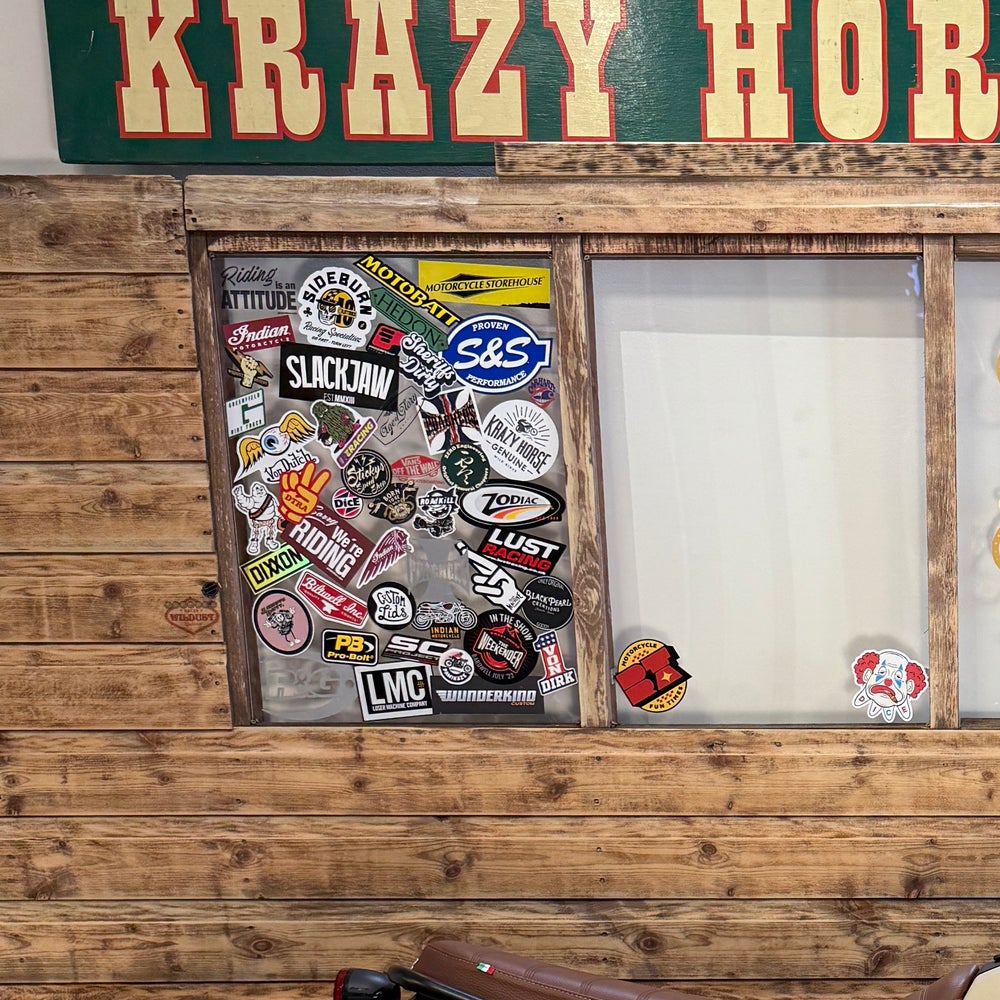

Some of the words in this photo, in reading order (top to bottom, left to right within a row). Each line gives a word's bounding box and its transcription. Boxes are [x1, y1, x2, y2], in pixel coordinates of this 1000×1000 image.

[114, 0, 628, 142] KRAZY
[222, 266, 278, 287] Riding
[284, 282, 296, 290] an
[424, 278, 485, 293] MOTORCYCLE
[486, 277, 543, 289] STOREHOUSE
[222, 290, 297, 311] ATTITUDE
[303, 271, 372, 315] SIDEBURN
[361, 255, 460, 327] MOTOBATT
[381, 293, 442, 347] HEDON
[472, 322, 509, 332] PROVEN
[228, 324, 291, 346] Indian
[453, 337, 532, 369] S&S
[286, 355, 395, 401] SLACKJAW
[466, 370, 527, 387] PERFORMANCE
[484, 414, 521, 448] KRAZY
[515, 440, 551, 474] HORSE
[400, 456, 421, 466] VANS
[491, 443, 527, 472] GENUINE
[406, 466, 420, 476] THE
[482, 493, 540, 516] ZODIAC
[289, 519, 357, 578] RIDING
[488, 528, 560, 559] LUST
[250, 547, 304, 585] DIXXON
[482, 543, 552, 571] RACING
[302, 578, 347, 607] Biltwell
[525, 589, 549, 604] BLACK
[548, 597, 572, 607] PEARL
[431, 626, 460, 634] INDIAN
[489, 613, 498, 623] IN
[499, 613, 514, 624] THE
[514, 620, 534, 641] SHOW
[335, 635, 364, 653] PB
[387, 635, 449, 656] SC
[477, 631, 524, 670] WEEKENDER
[622, 643, 657, 666] MOTORCYCLE
[327, 651, 371, 662] Pro-Bolt
[543, 645, 563, 677] VON
[366, 669, 426, 706] LMC
[541, 671, 575, 693] DIRK
[406, 700, 428, 708] COMPANY
[436, 690, 536, 702] WUNDERKIND
[667, 686, 683, 705] TIMES
